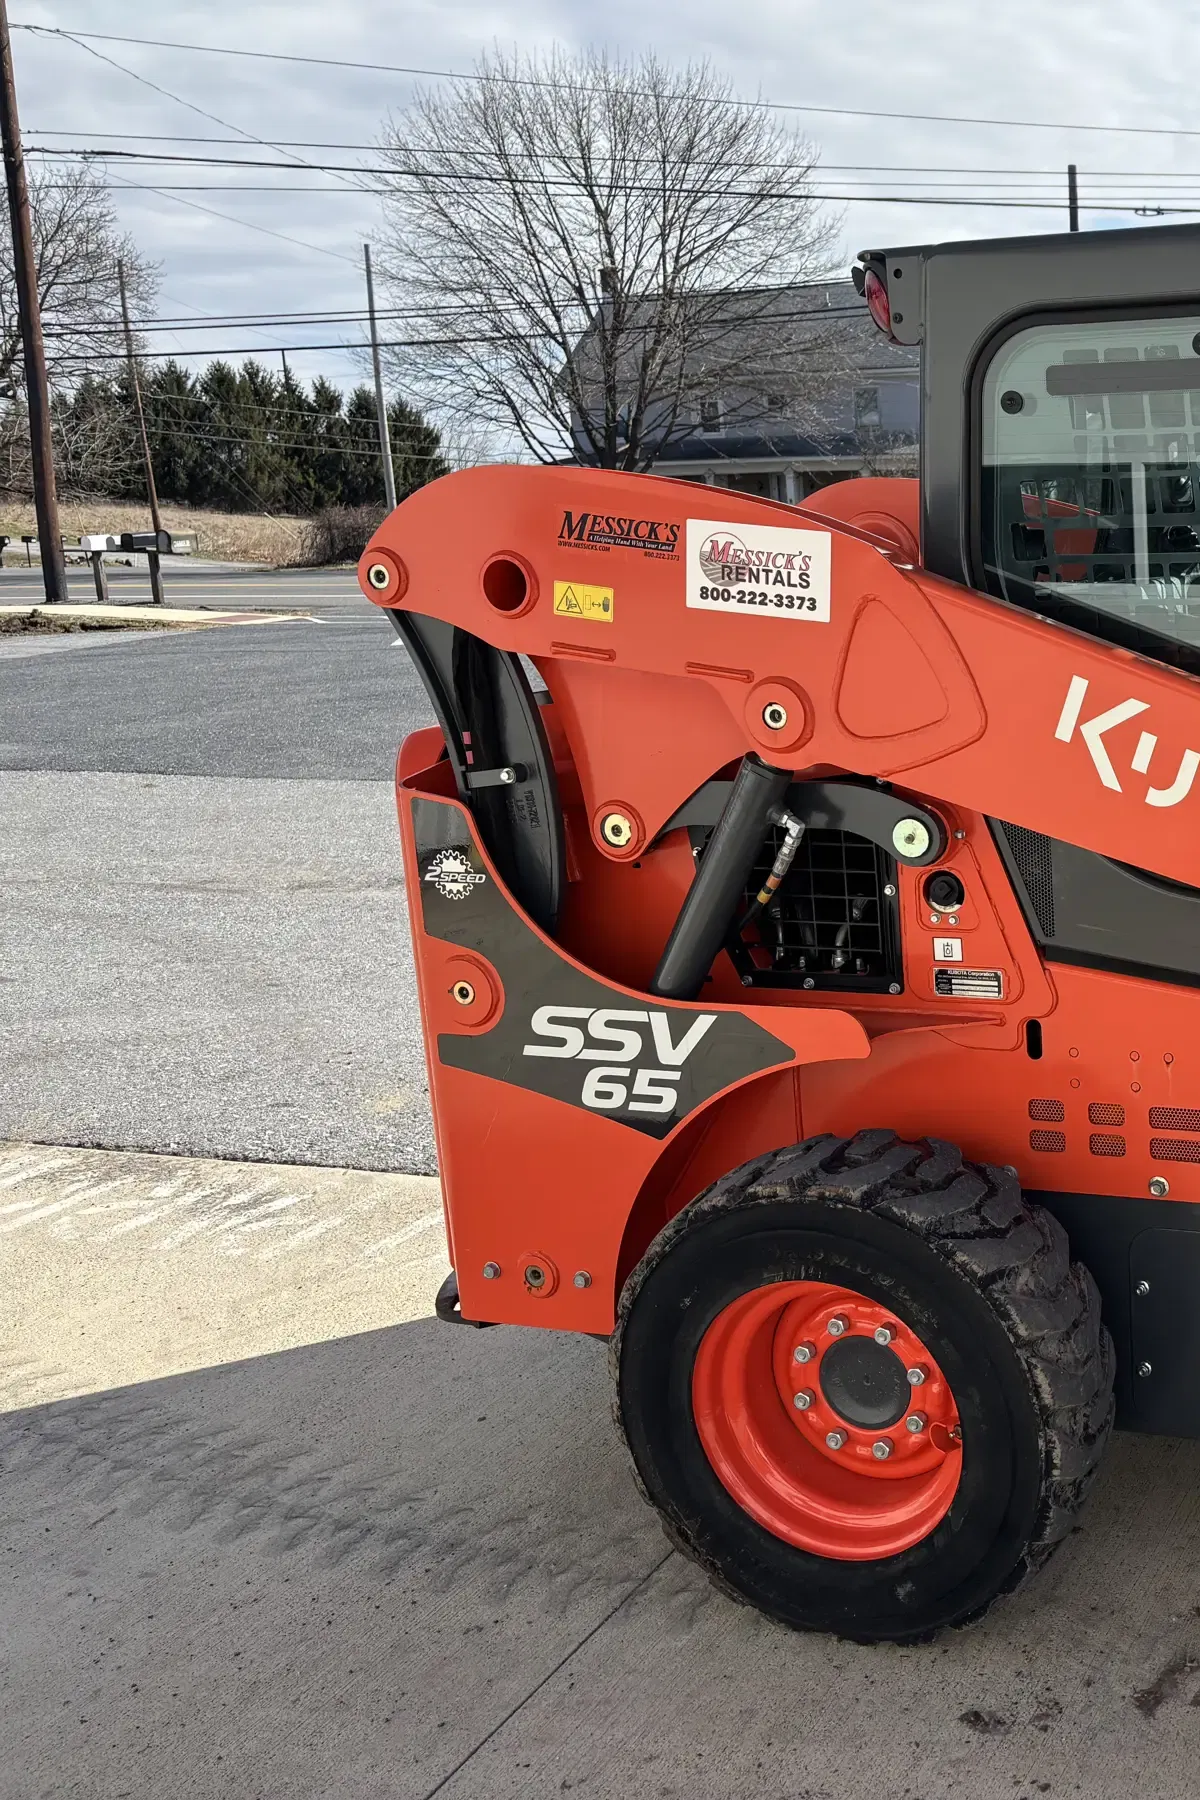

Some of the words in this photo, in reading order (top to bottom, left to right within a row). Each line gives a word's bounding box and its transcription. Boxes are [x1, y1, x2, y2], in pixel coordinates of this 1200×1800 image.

[558, 511, 680, 542] MESSICK'S
[594, 535, 614, 544] Helping
[631, 539, 644, 547] With
[645, 541, 658, 549] Your
[658, 543, 673, 551] Land
[705, 539, 812, 572] MESSICK'S
[721, 564, 811, 589] RENTALS
[699, 586, 817, 611] 800-222-3373
[522, 1005, 718, 1066] SSV
[581, 1066, 682, 1113] 65
